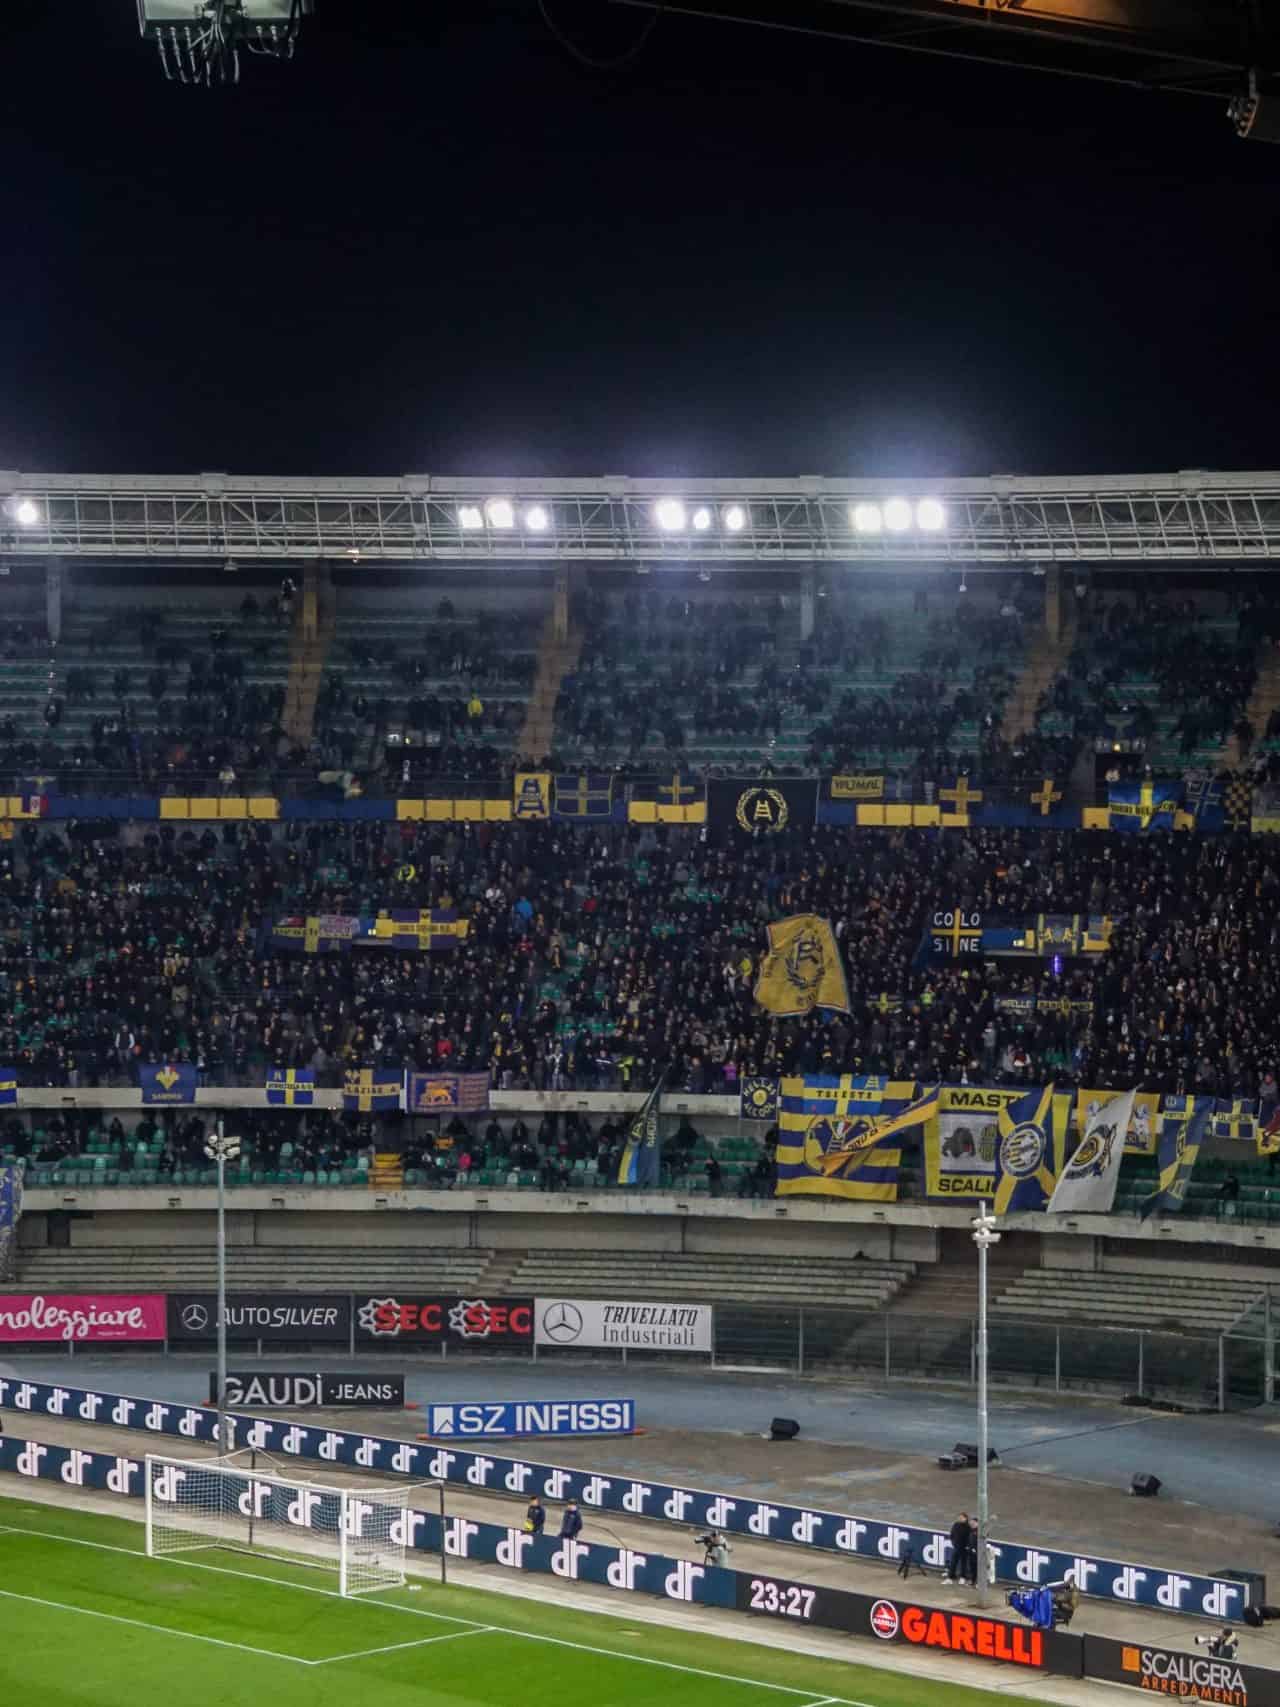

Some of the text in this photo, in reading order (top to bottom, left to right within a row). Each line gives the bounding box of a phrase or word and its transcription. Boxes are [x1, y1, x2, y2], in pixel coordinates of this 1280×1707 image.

[374, 1303, 442, 1331] SEC
[464, 1304, 531, 1334] SEC
[602, 1305, 699, 1327] TRIVELLATO
[602, 1325, 696, 1346] Industriali
[459, 1402, 630, 1433] SZ INFISSI
[15, 1384, 37, 1410] dr
[47, 1388, 70, 1415] dr
[79, 1393, 102, 1420] dr
[112, 1398, 135, 1425] dr
[145, 1404, 169, 1431] dr
[178, 1409, 202, 1437] dr
[247, 1421, 273, 1448] dr
[282, 1426, 308, 1454] dr
[318, 1432, 344, 1460] dr
[355, 1438, 381, 1466] dr
[392, 1444, 418, 1473] dr
[429, 1451, 455, 1479] dr
[467, 1456, 494, 1486] dr
[504, 1463, 532, 1492] dr
[543, 1469, 571, 1499] dr
[582, 1476, 611, 1506] dr
[622, 1483, 651, 1513] dr
[664, 1490, 693, 1520] dr
[706, 1497, 735, 1528] dr
[748, 1504, 779, 1536] dr
[791, 1511, 822, 1543] dr
[835, 1519, 867, 1551] dr
[878, 1527, 909, 1558] dr
[1016, 1551, 1049, 1582] dr
[1112, 1567, 1147, 1600] dr
[1156, 1575, 1191, 1608] dr
[1202, 1583, 1238, 1616] dr
[16, 1441, 47, 1477] dr
[61, 1449, 92, 1486] dr
[106, 1457, 138, 1494] dr
[154, 1466, 186, 1502] dr
[238, 1480, 271, 1517] dr
[287, 1488, 321, 1527] dr
[389, 1508, 425, 1547] dr
[444, 1518, 479, 1557] dr
[496, 1528, 534, 1568] dr
[551, 1538, 589, 1578] dr
[607, 1549, 647, 1590] dr
[665, 1560, 705, 1601] dr
[750, 1580, 816, 1618] 23:27
[901, 1607, 1044, 1667] GARELLI
[1141, 1650, 1247, 1693] SCALIGERA
[1140, 1675, 1248, 1707] ARREDAMENTI
